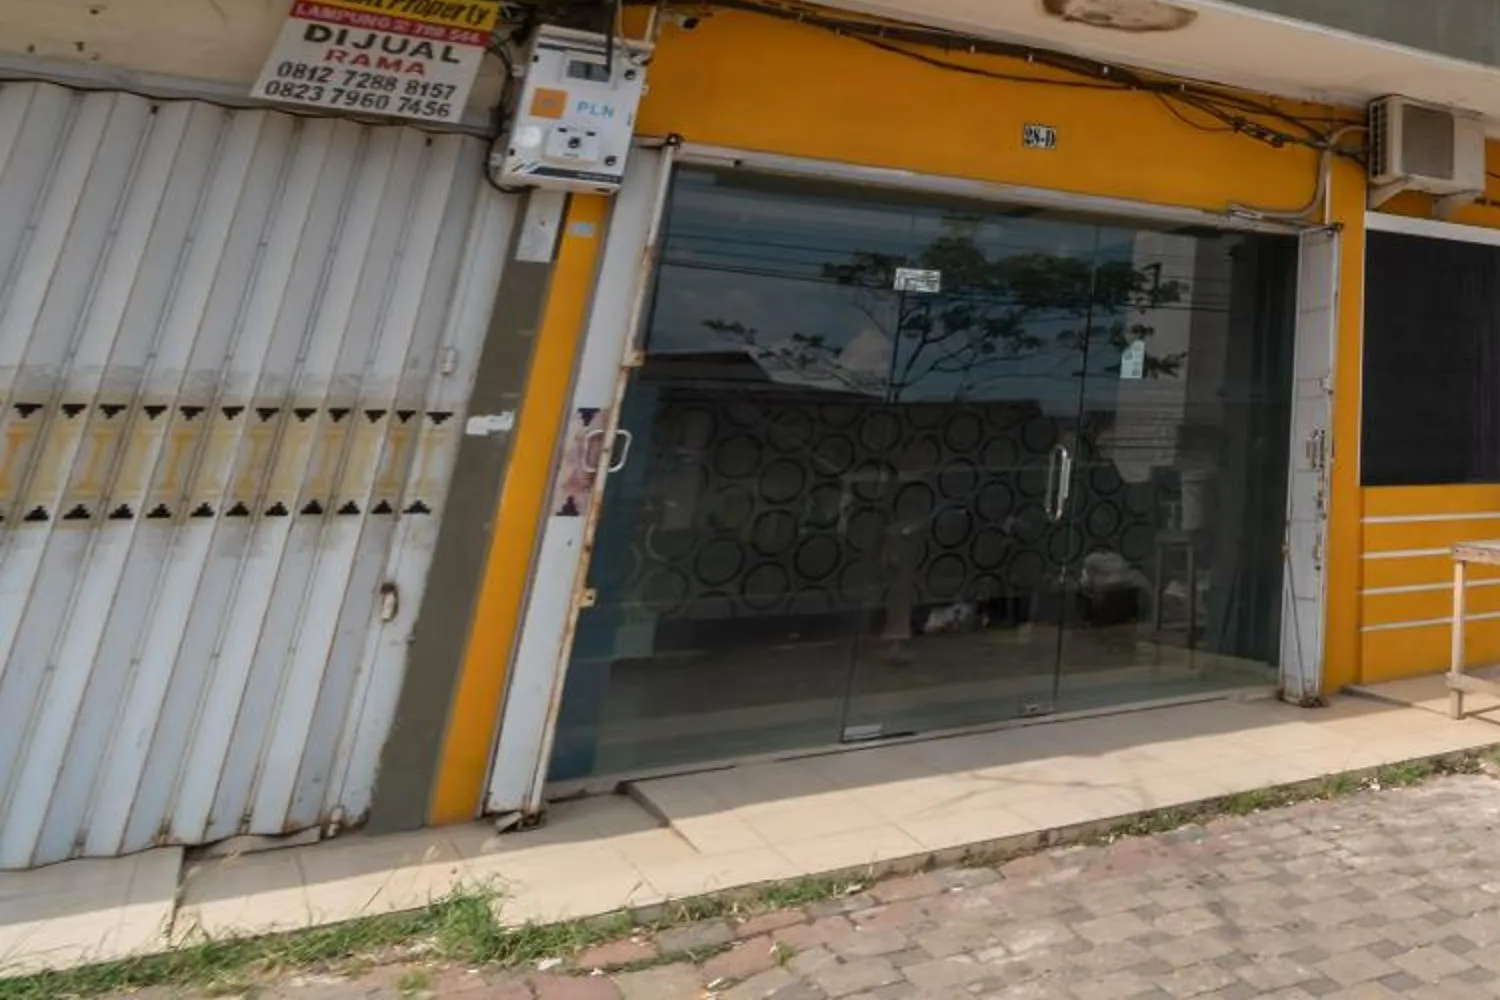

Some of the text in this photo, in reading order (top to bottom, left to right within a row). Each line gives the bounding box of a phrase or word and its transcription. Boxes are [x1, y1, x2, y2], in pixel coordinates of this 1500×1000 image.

[297, 2, 391, 29] LAMPUNG
[303, 23, 461, 64] DIJUAL
[324, 48, 426, 76] RAMA
[277, 61, 457, 101] 0812 7288 8157
[264, 79, 450, 119] 0823 7960 7456
[576, 101, 615, 119] PLN
